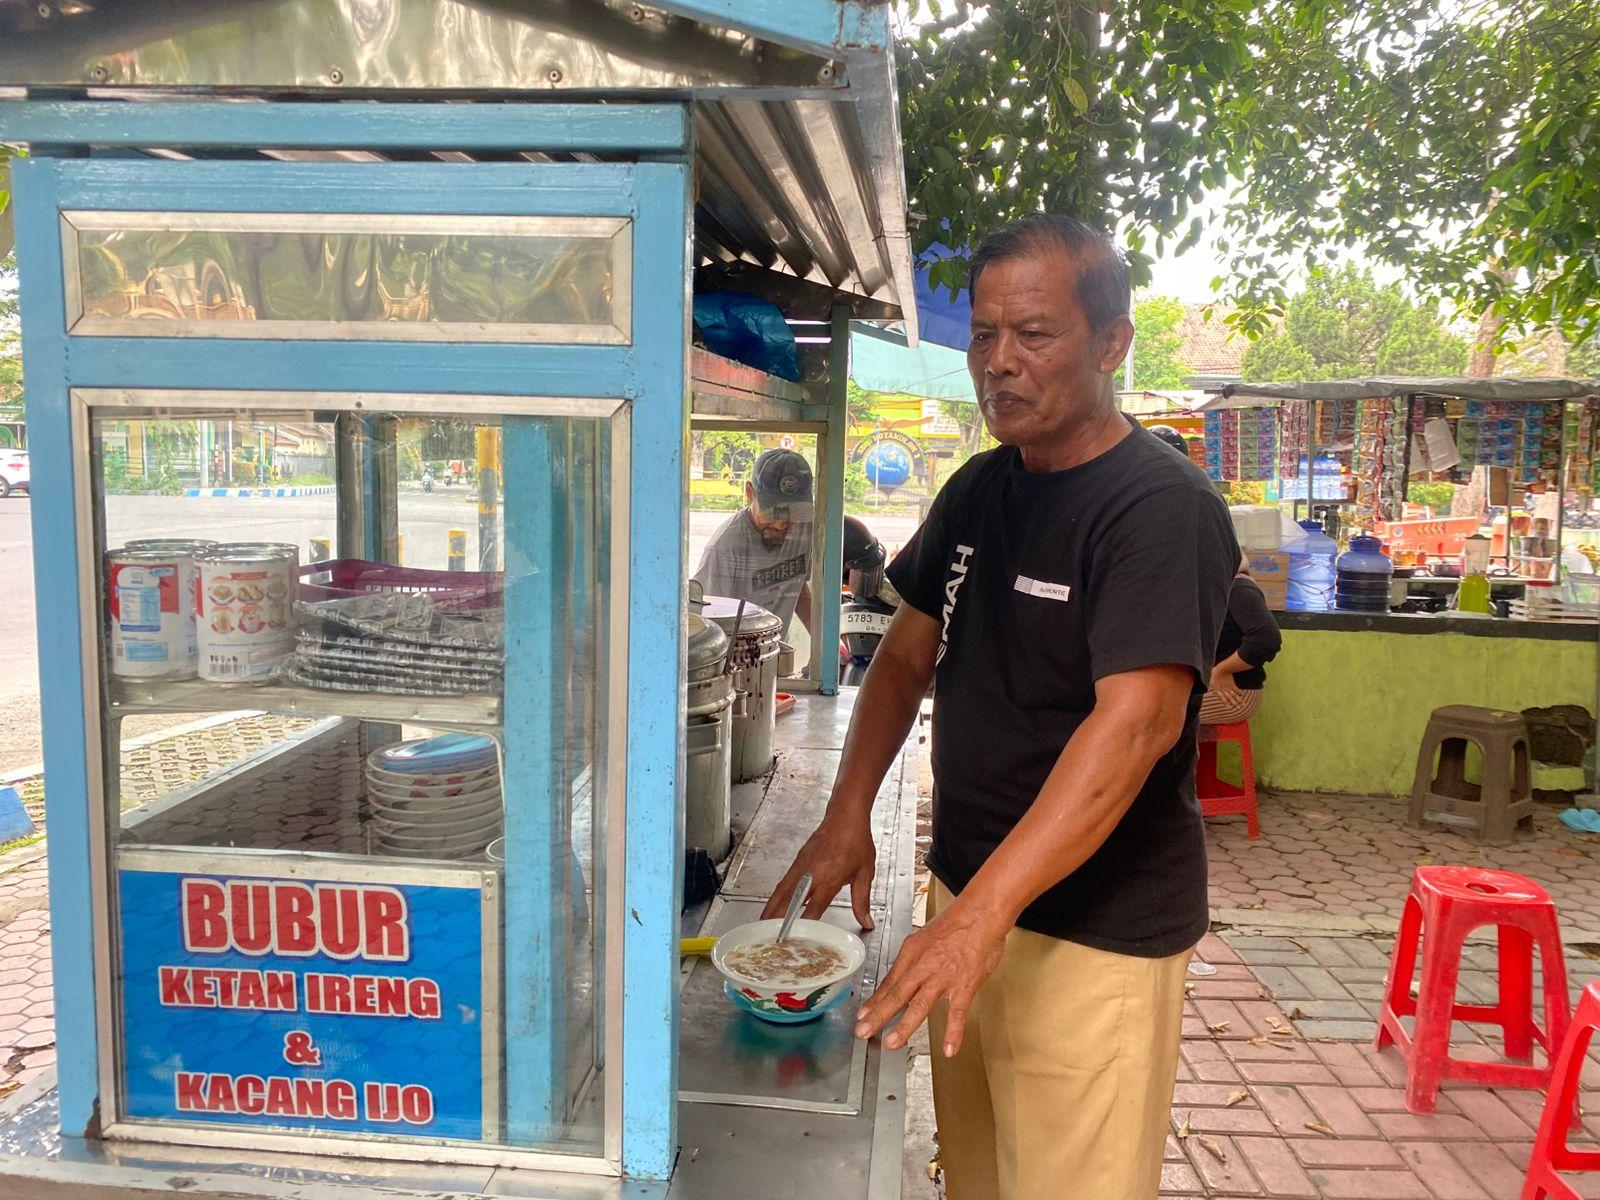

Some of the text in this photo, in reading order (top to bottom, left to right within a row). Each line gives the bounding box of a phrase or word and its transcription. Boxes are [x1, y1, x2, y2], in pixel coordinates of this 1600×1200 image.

[847, 613, 873, 623] 5783
[181, 878, 411, 963] BUBUR
[158, 966, 442, 1020] KETAN IRENG
[283, 1031, 321, 1067] &
[175, 1072, 434, 1125] KACANG IJO
